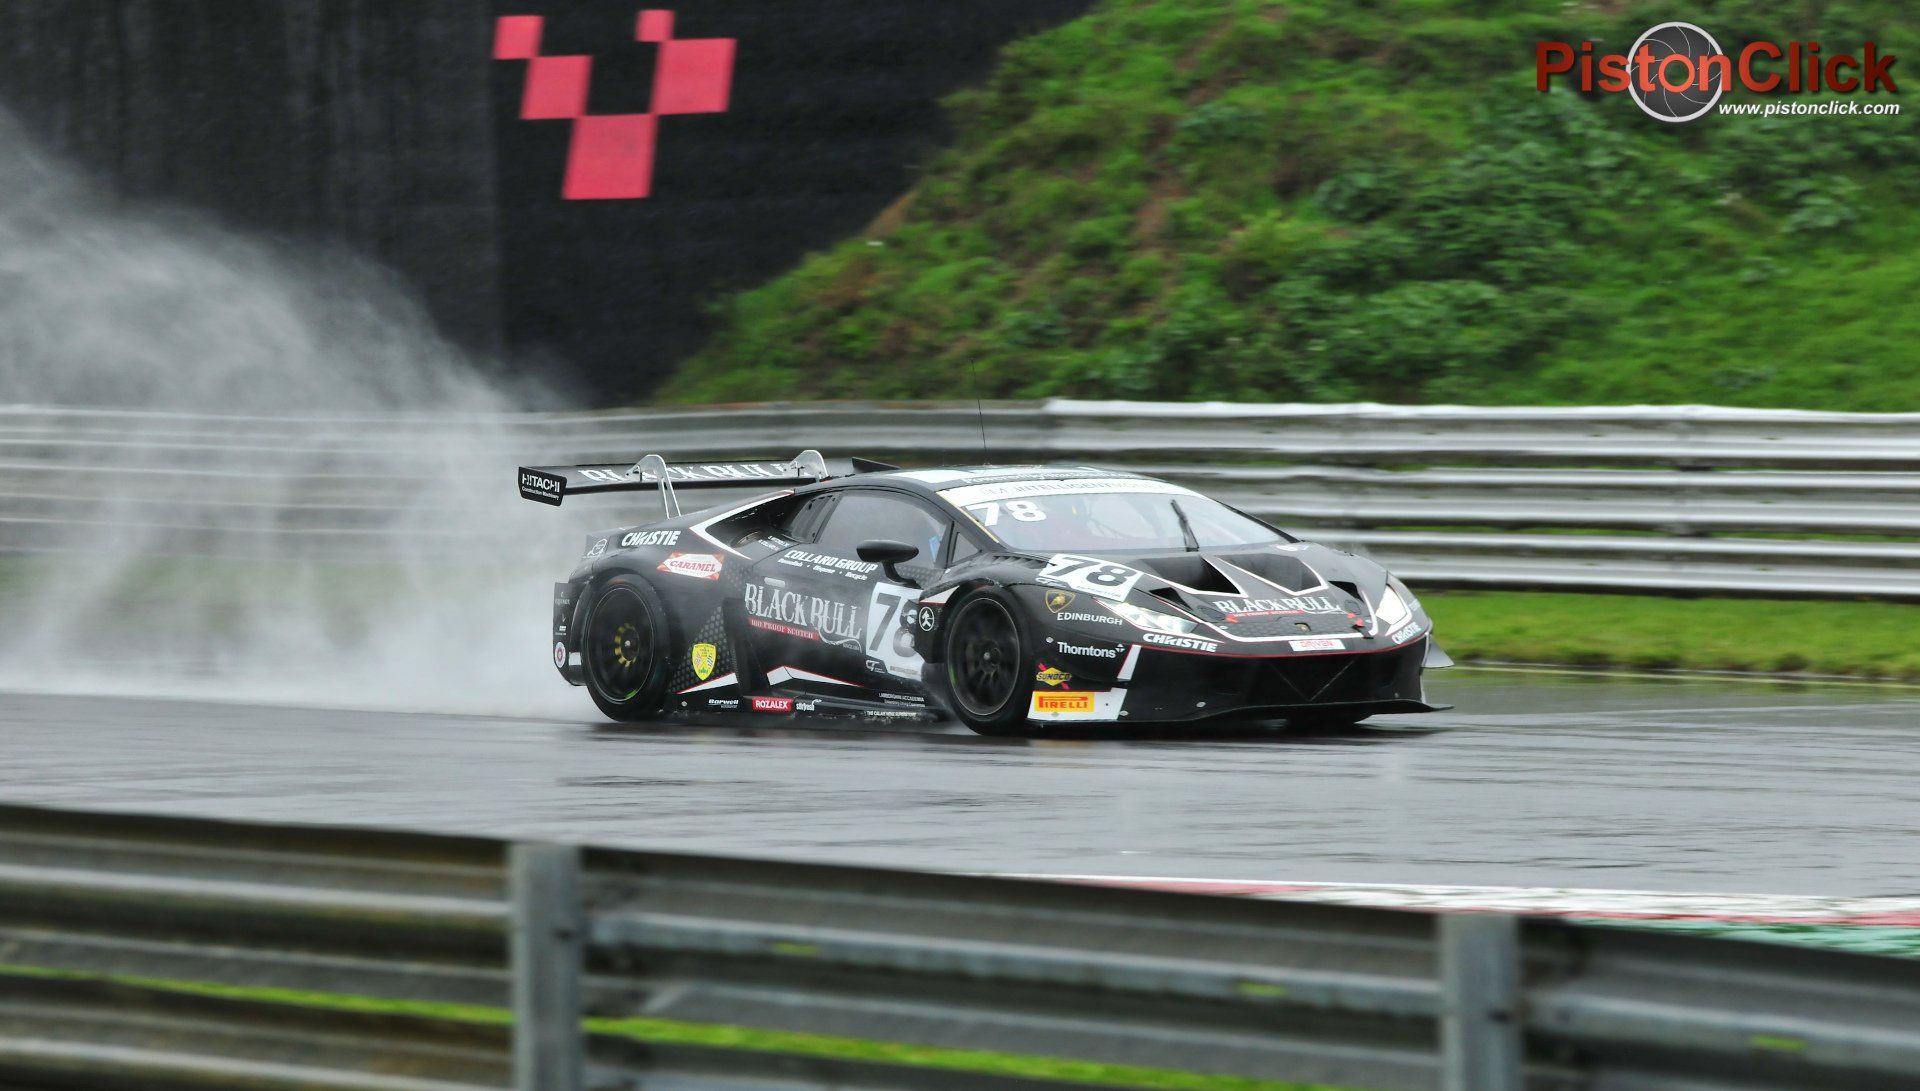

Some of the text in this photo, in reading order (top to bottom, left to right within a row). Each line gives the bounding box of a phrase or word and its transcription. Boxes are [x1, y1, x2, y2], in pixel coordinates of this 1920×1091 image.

[522, 473, 560, 492] HITACHI
[966, 500, 1047, 526] 78
[621, 530, 681, 547] CHRISTIE
[669, 560, 717, 572] CARAMEL
[784, 550, 879, 574] COLLARD GROUP
[1046, 556, 1137, 587] 78
[745, 582, 862, 641] BLACK BULL
[1213, 598, 1284, 614] BLACK
[1281, 596, 1341, 612] BULL
[1057, 612, 1123, 626] EDINBURGH
[1057, 641, 1117, 659] Thorntons
[1143, 633, 1218, 653] CHRISTIE
[1036, 672, 1072, 682] SUNOCO
[755, 699, 788, 710] ROZALEX
[1038, 696, 1089, 709] PIRELLI
